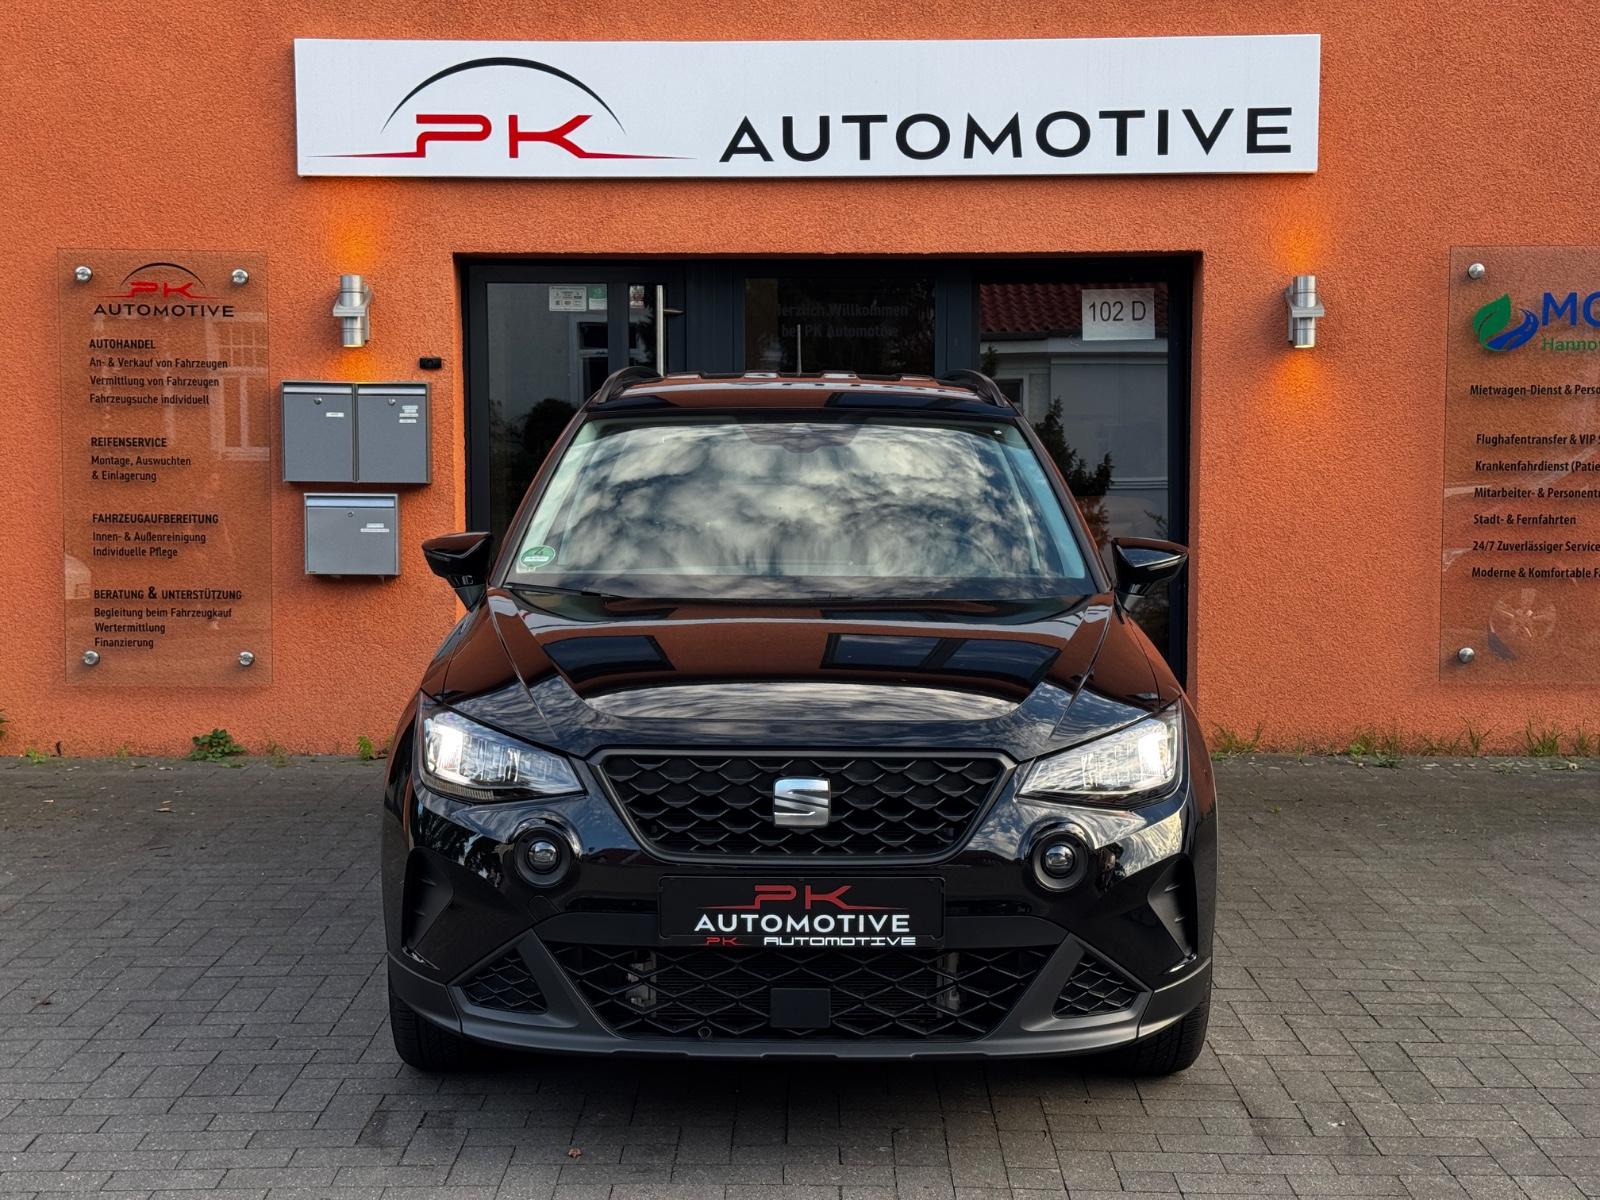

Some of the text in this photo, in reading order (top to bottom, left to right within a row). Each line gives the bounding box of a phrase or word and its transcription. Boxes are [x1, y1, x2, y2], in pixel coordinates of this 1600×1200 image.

[415, 106, 1292, 163] PK AUTOMOTIVE
[128, 281, 194, 298] PK
[93, 303, 235, 317] AUTOMOTIVE
[1088, 300, 1147, 322] 102 D
[89, 339, 156, 349] AUTOHANDEL
[89, 357, 228, 370] An- & Verkauf von Fahrzeugen
[90, 375, 219, 389] Vermittlung von Fahrzeugen
[1470, 385, 1562, 397] Mietwagen-Dienst
[1564, 385, 1572, 395] &
[90, 393, 209, 406] Fahrzeugsuche individuell
[91, 437, 167, 448] REIFENSERVICE
[1476, 433, 1567, 447] Flughafentransfer
[1569, 434, 1577, 445] &
[1579, 434, 1596, 445] VIP
[91, 455, 191, 467] Montage, Auswuchten
[1475, 460, 1569, 472] Krankenfahrdienst
[92, 471, 157, 482] & Einlagerung
[1474, 487, 1535, 498] Mitarbeiter-
[1537, 488, 1545, 498] &
[92, 513, 219, 524] FAHRZEUGAUFBEREITUNG
[1473, 514, 1576, 525] Stadt- & Fernfahrten
[92, 532, 206, 544] Innen- & Außenreinigung
[93, 546, 178, 559] Individuelle Pflege
[1473, 540, 1600, 553] 24/7 Zuverlässiger Service
[1472, 567, 1515, 578] Moderne
[1518, 567, 1526, 578] &
[1528, 567, 1591, 578] Komfortable
[94, 586, 242, 600] BERATUNG & UNTERSTÜTZUNG
[94, 607, 232, 620] Begleitung beim Fahrzeugkauf
[94, 622, 165, 634] Wertermittlung
[94, 637, 154, 649] Finanzierung
[754, 885, 852, 910] PK
[694, 914, 910, 933] AUTOMOTIVE
[705, 937, 916, 946] PK AUTOMOTIVE
